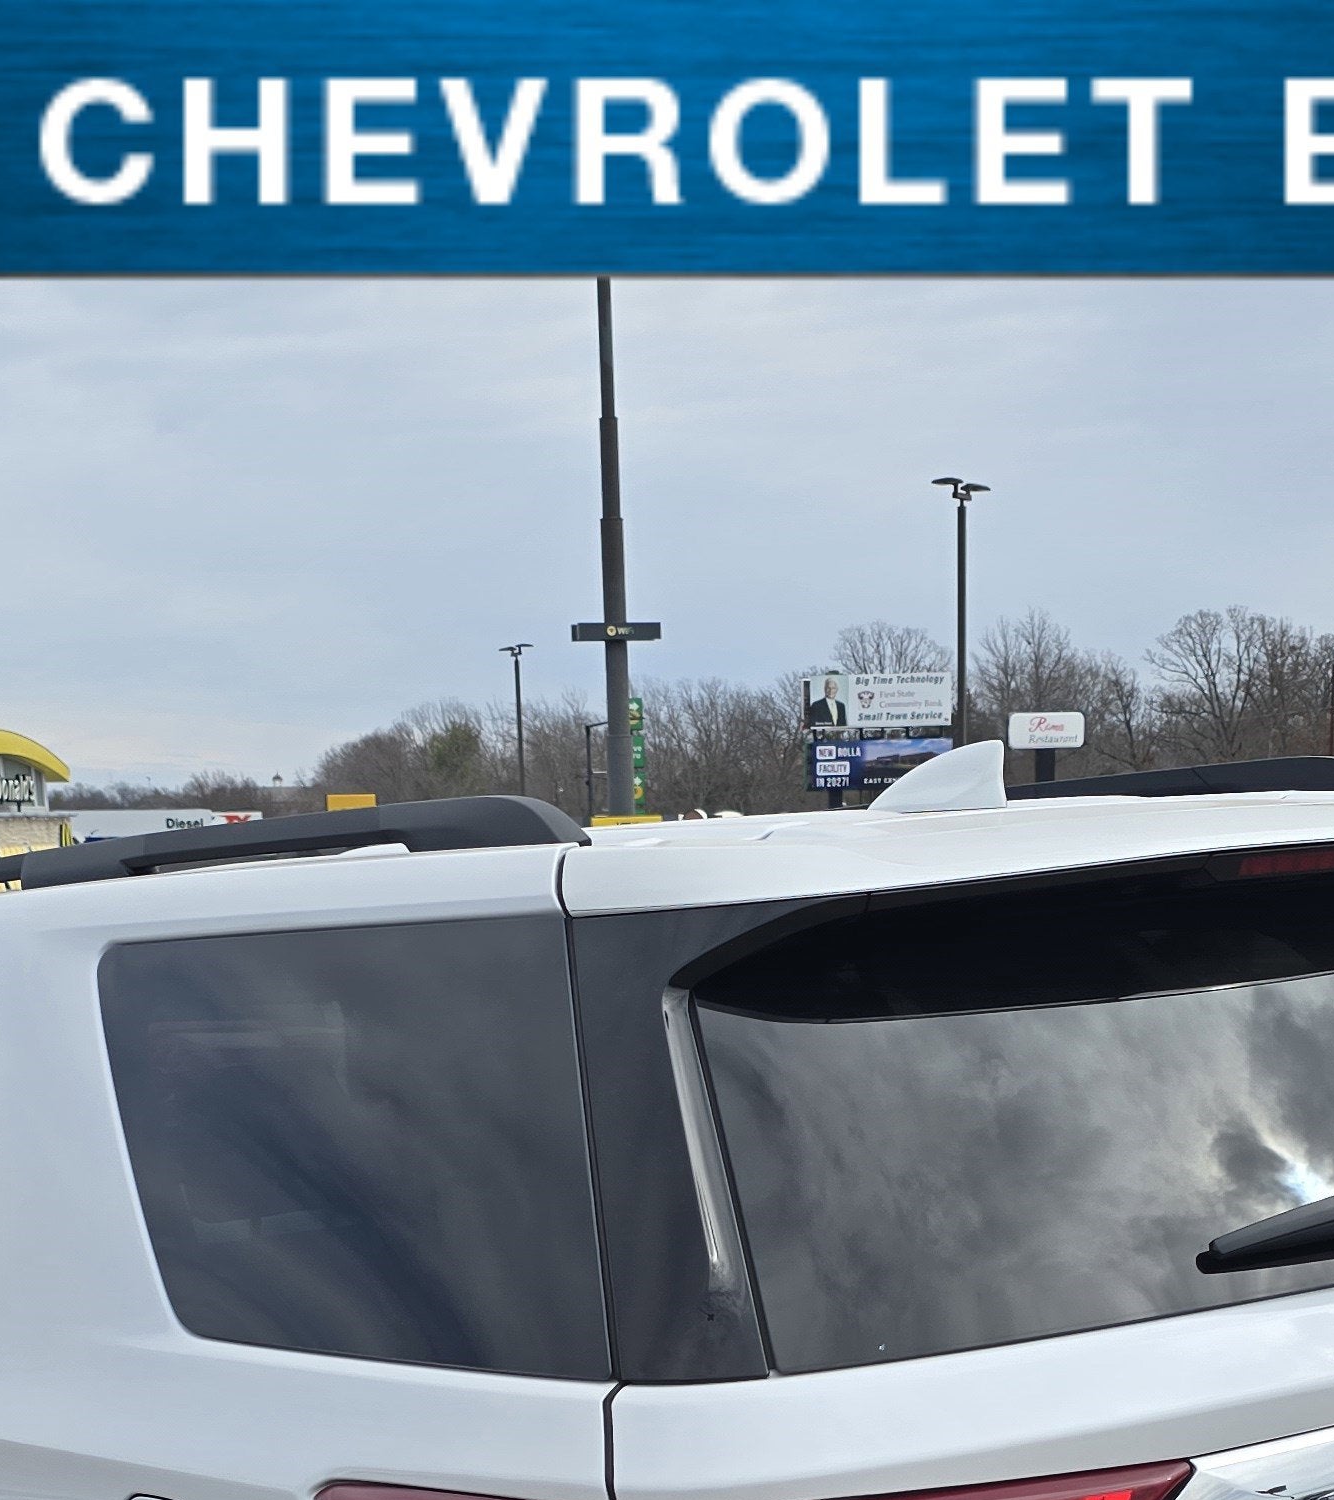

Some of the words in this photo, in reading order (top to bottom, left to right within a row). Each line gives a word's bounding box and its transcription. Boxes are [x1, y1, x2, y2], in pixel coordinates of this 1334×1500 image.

[855, 676, 870, 687] Big
[872, 675, 893, 685] Time
[896, 675, 945, 685] Technology
[857, 712, 883, 721] Small
[885, 712, 908, 721] Town
[910, 711, 943, 720] Service
[166, 817, 204, 829] Diesel
